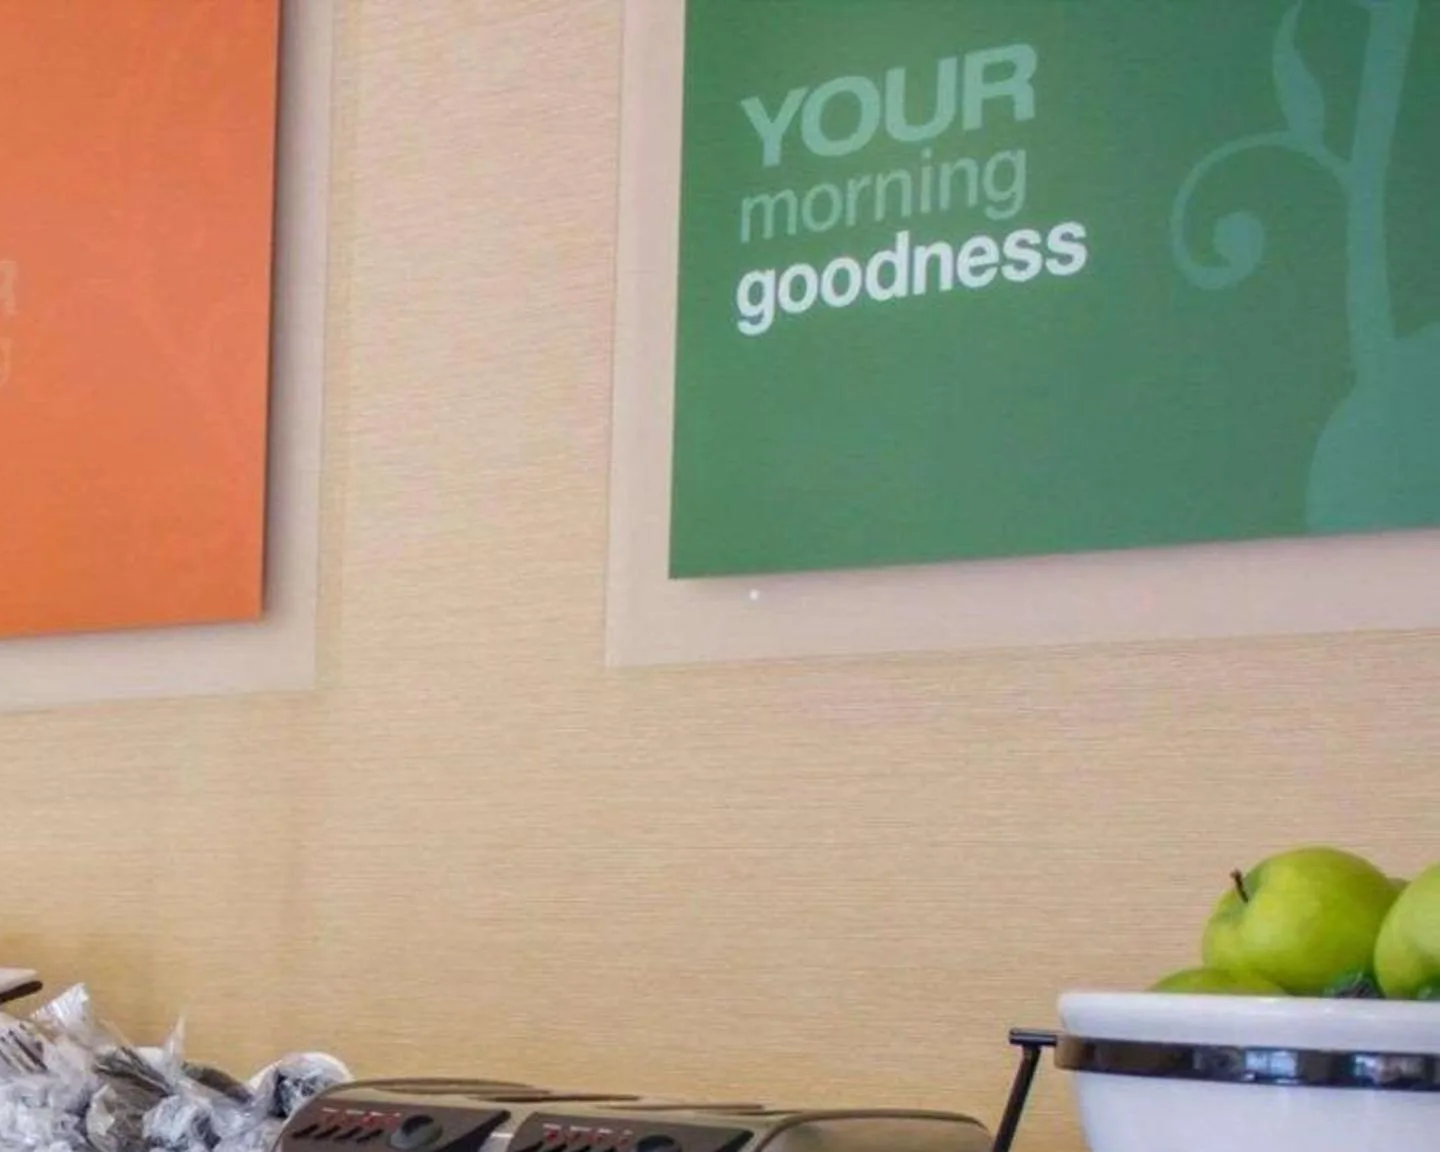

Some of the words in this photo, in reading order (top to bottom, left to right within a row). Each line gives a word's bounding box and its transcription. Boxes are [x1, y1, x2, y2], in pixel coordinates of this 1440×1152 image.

[741, 43, 1038, 167] YOUR
[740, 147, 1027, 243] morning
[736, 221, 1089, 336] goodness
